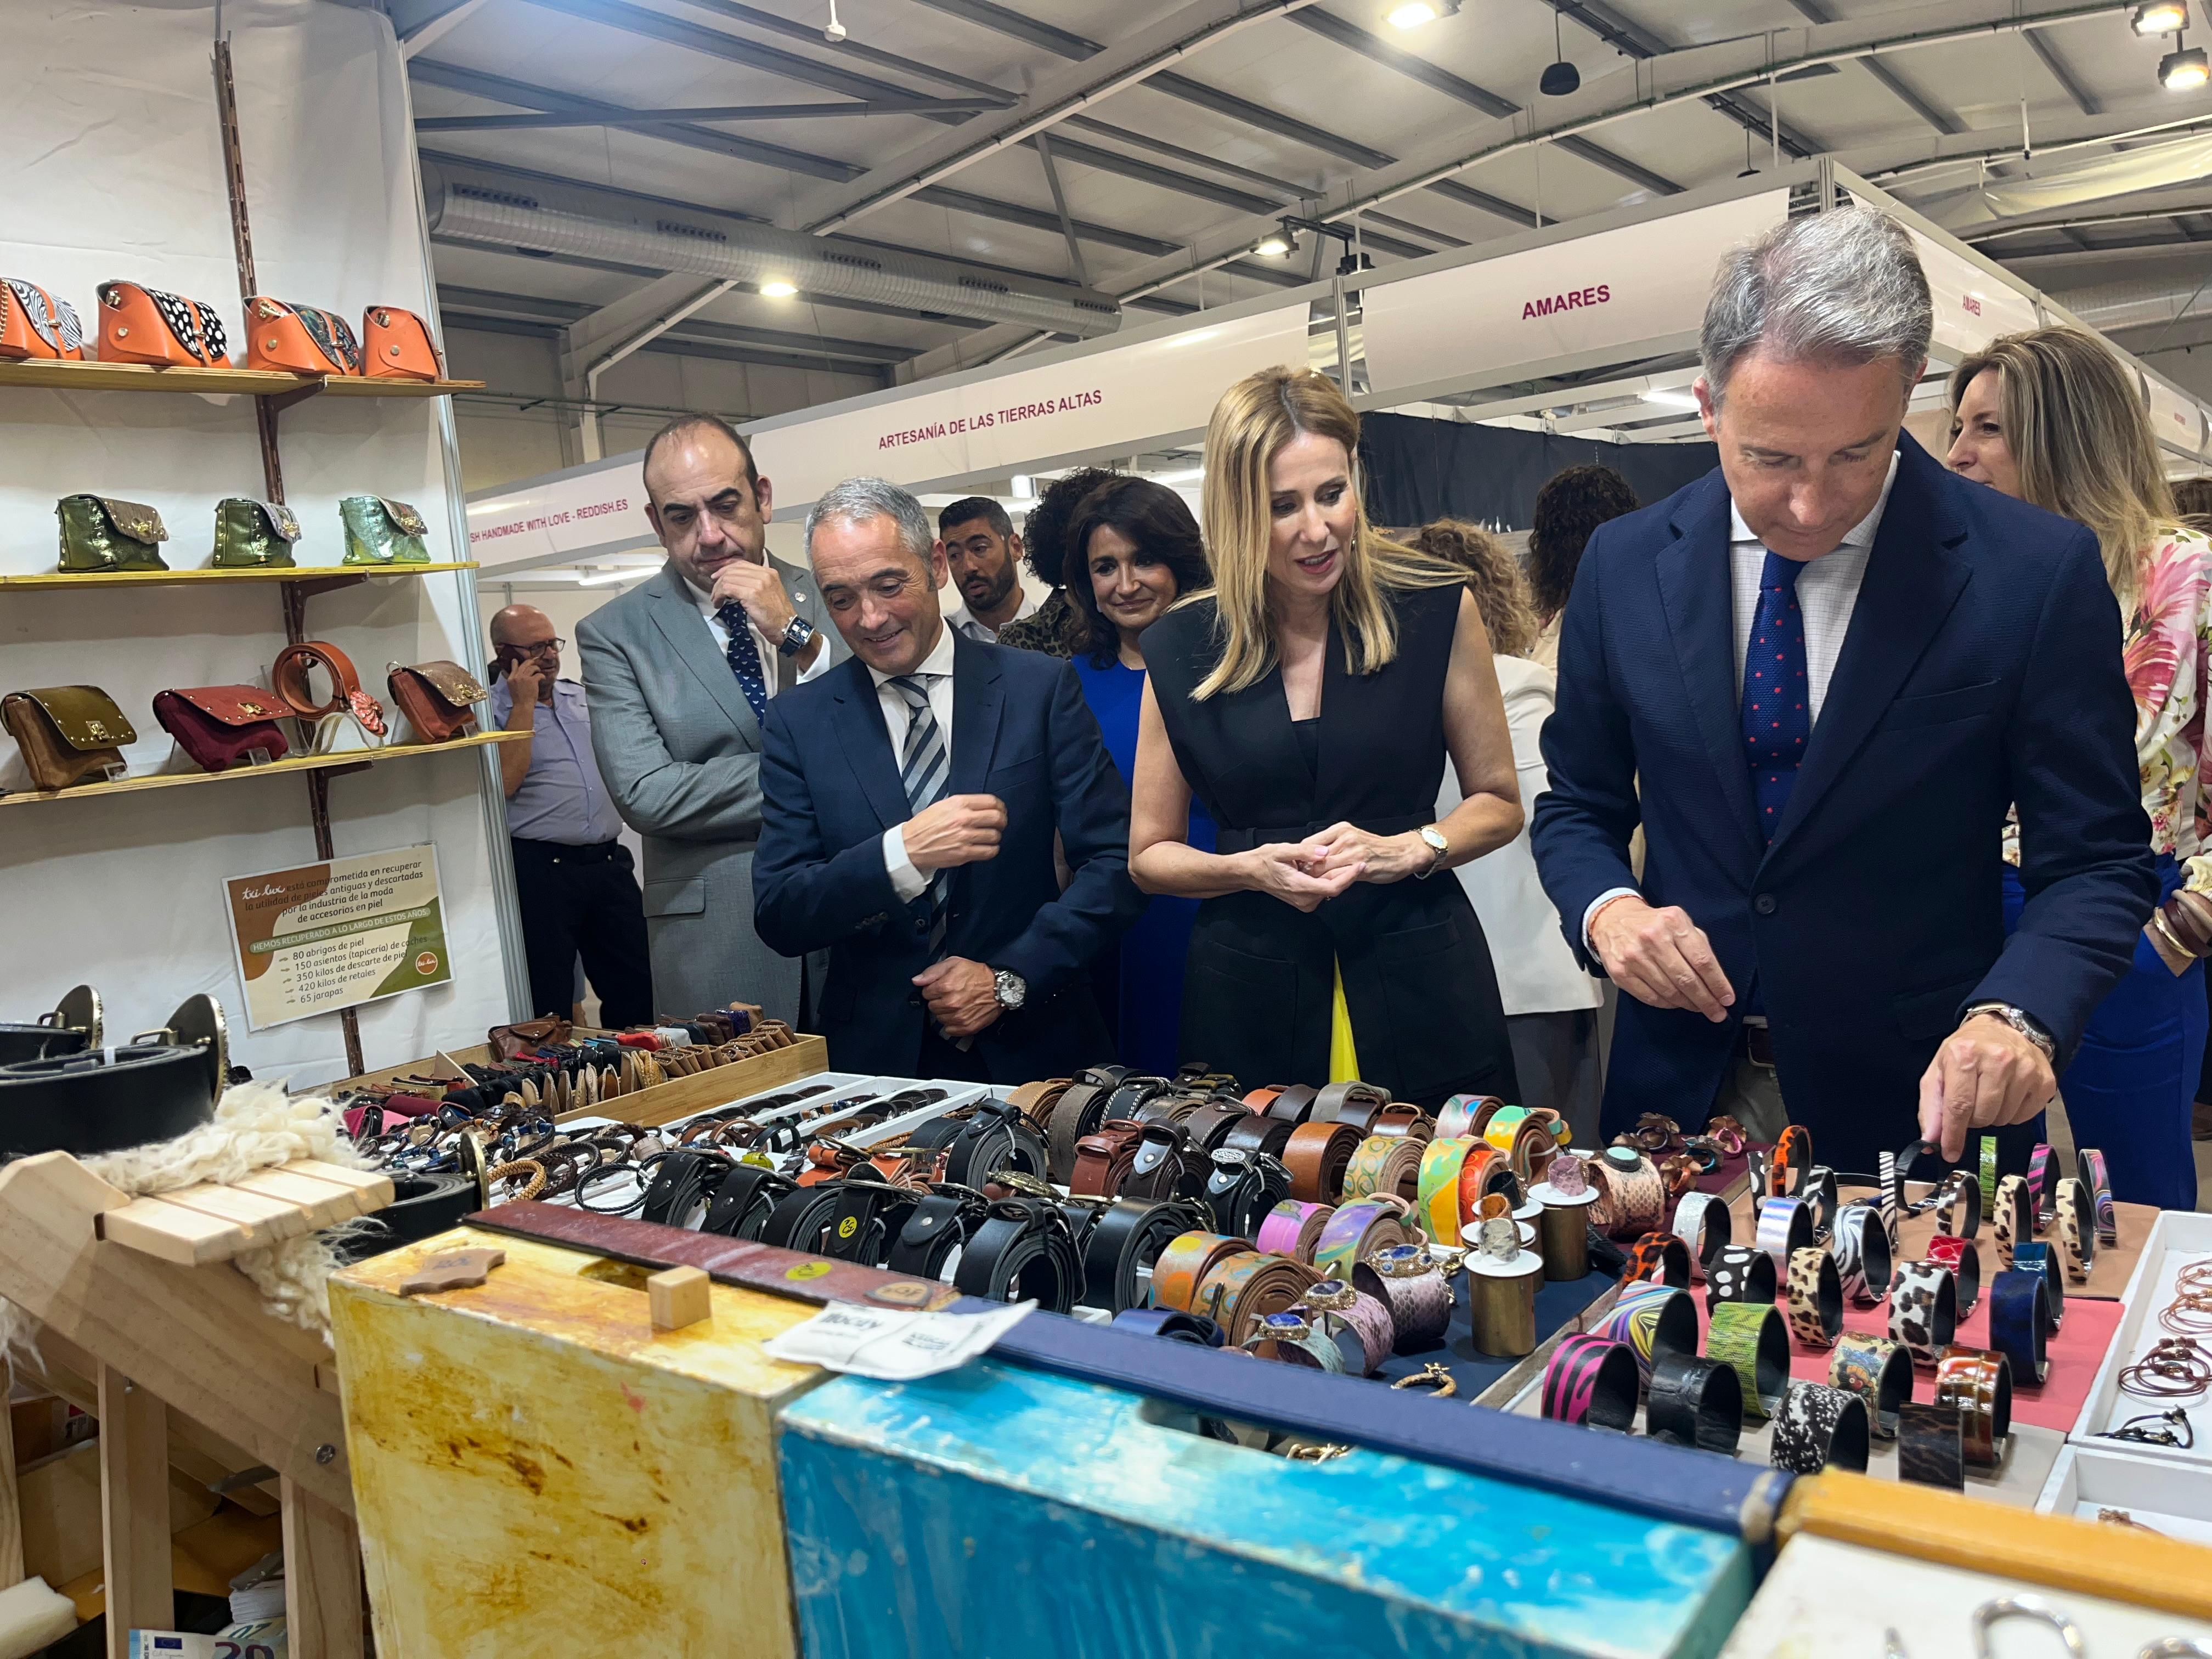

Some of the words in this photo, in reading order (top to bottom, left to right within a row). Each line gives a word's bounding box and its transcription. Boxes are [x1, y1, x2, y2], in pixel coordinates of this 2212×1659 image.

[1522, 284, 1611, 320] AMARES
[878, 421, 946, 450] ARTESANÍA
[949, 419, 966, 435] DE
[969, 413, 995, 430] LAS
[997, 399, 1055, 424] TIERRAS
[1058, 390, 1102, 412] ALTAS
[481, 521, 525, 540] HANDMADE
[526, 516, 547, 531] WITH
[548, 511, 571, 527] LOVE
[576, 499, 629, 520] REDDISH.ES
[245, 902, 253, 912] la
[256, 896, 289, 909] utilidad
[291, 893, 302, 902] de
[303, 890, 329, 902] pieles
[330, 881, 366, 895] antiguas
[368, 881, 373, 890] y
[375, 871, 424, 886] descartadas
[286, 881, 304, 892] está
[306, 870, 368, 889] comprometida
[382, 861, 422, 874] recuperar
[281, 906, 297, 918] por
[299, 903, 307, 912] la
[309, 895, 347, 909] industria
[348, 893, 359, 902] de
[360, 890, 368, 900] la
[370, 887, 393, 898] moda
[297, 915, 308, 923] de
[310, 906, 354, 921] accesorios
[356, 904, 366, 912] en
[368, 898, 383, 911] piel
[253, 938, 281, 951] HEMOS
[281, 929, 330, 945] RECUPERADO
[338, 925, 348, 933] LO
[349, 919, 374, 932] LARGO
[374, 917, 384, 926] DE
[385, 913, 407, 923] ESTOS
[293, 950, 304, 961] 80
[306, 945, 336, 958] abrigos
[338, 941, 348, 950] de
[349, 937, 364, 950] piel
[295, 960, 312, 971] 150
[313, 953, 347, 967] asientos
[348, 943, 388, 960] (tapicería)
[390, 941, 399, 950] de
[401, 936, 427, 947] coches
[296, 970, 313, 982] 350
[315, 967, 334, 978] kilos
[336, 964, 346, 973] de
[347, 957, 381, 970] descarte
[382, 953, 392, 962] de
[393, 949, 408, 961] piel
[298, 981, 315, 992] 420
[317, 978, 336, 988] kilos
[337, 974, 347, 983] de
[349, 969, 376, 981] retales
[300, 994, 312, 1003] 65
[313, 987, 343, 1003] jarapas
